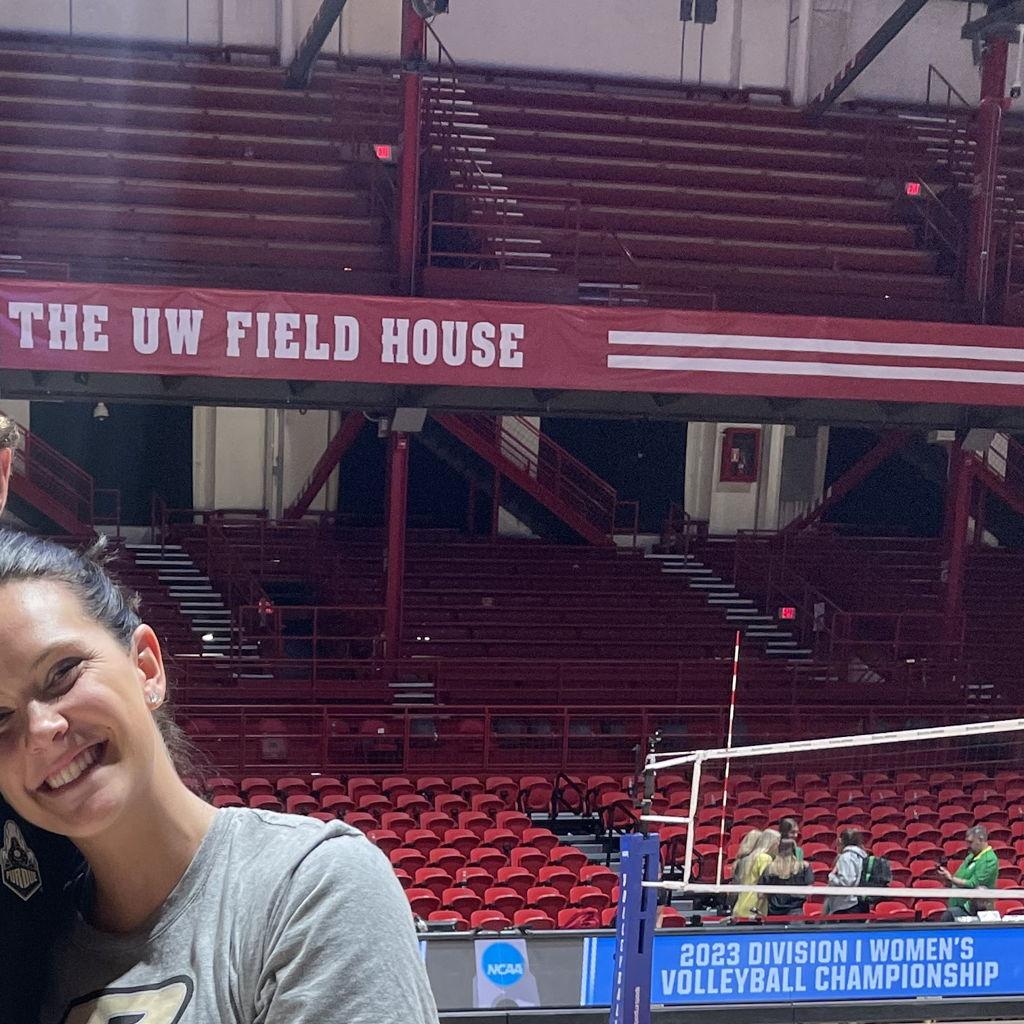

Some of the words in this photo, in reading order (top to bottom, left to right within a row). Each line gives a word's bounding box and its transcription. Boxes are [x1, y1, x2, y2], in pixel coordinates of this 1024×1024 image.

[8, 302, 108, 351] THE
[132, 308, 203, 355] UW
[226, 312, 359, 361] FIELD
[381, 318, 524, 368] HOUSE
[680, 942, 740, 966] 2023
[748, 940, 847, 965] DIVISION
[856, 940, 862, 962] I
[870, 937, 973, 962] WOMEN'S
[487, 963, 523, 975] NCAA
[661, 967, 806, 995] VOLLEYBALL
[815, 961, 998, 991] CHAMPIONSHIP
